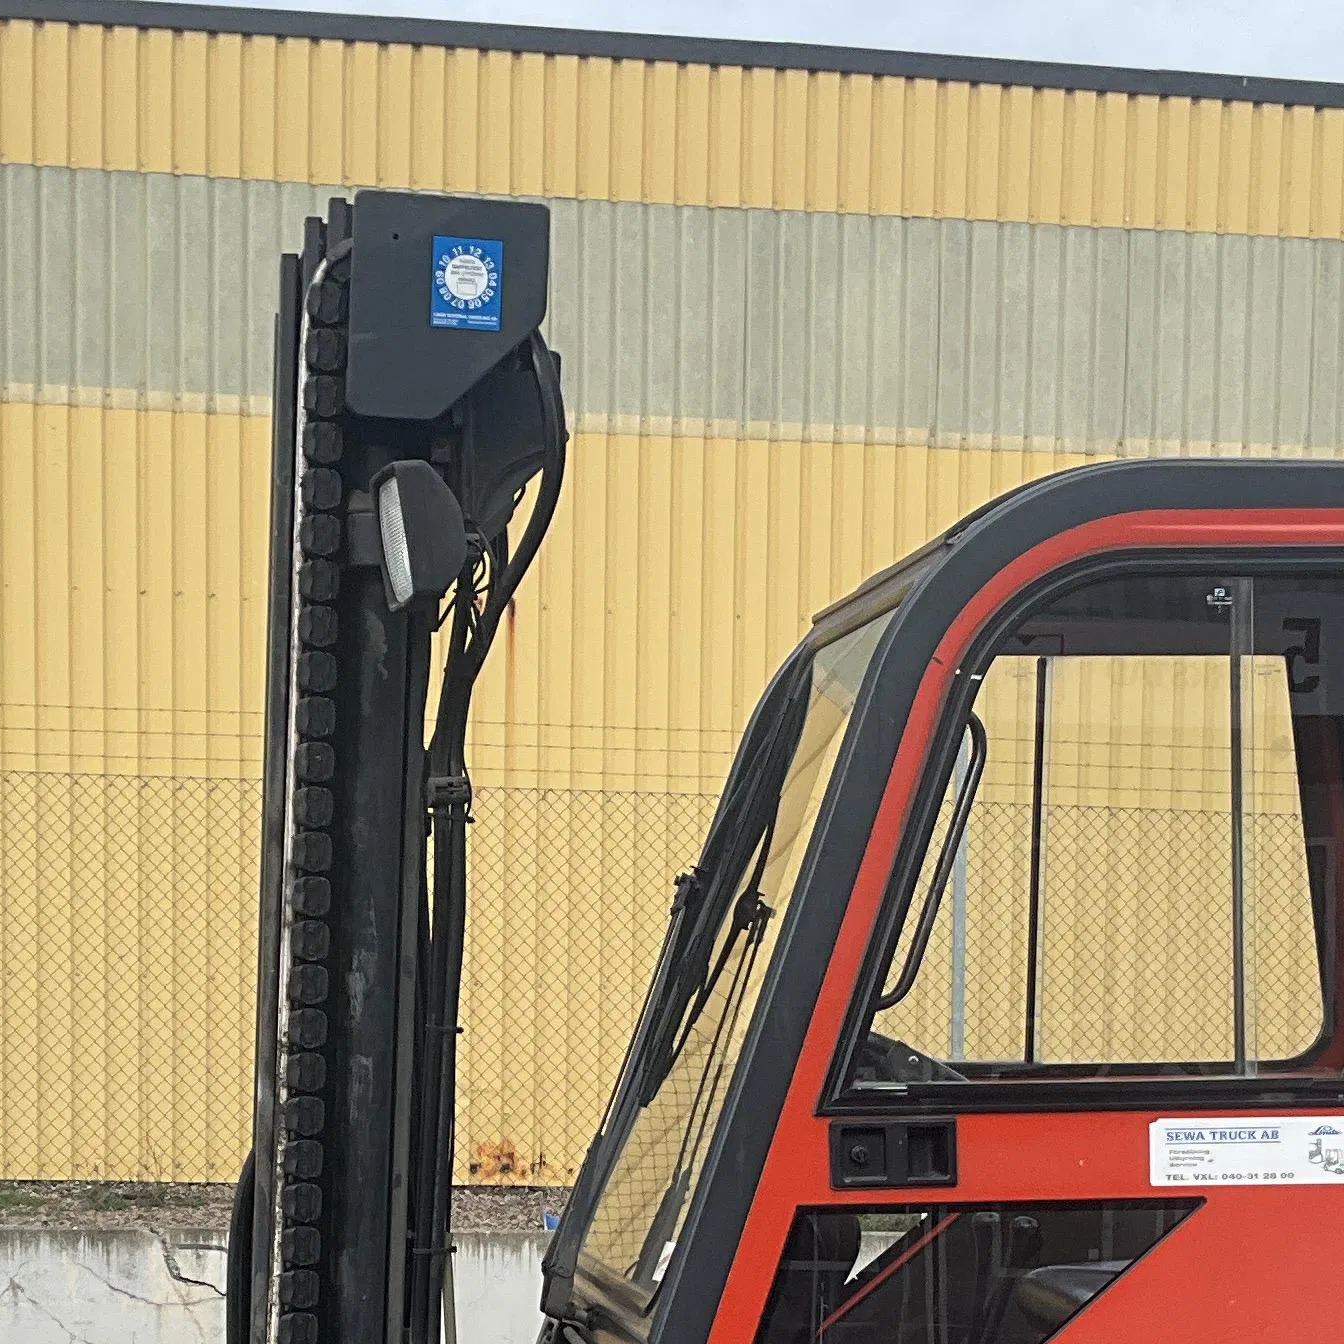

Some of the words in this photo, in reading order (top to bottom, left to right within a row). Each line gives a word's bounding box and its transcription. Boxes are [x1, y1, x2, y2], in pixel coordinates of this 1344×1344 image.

[452, 245, 463, 256] 11
[469, 245, 482, 258] 12
[438, 254, 451, 267] 10
[481, 288, 494, 304] 05
[450, 299, 465, 310] 07
[467, 299, 482, 309] 06
[1166, 1131, 1205, 1142] SEWA
[1209, 1130, 1257, 1141] TRUCK
[1260, 1130, 1280, 1140] AB
